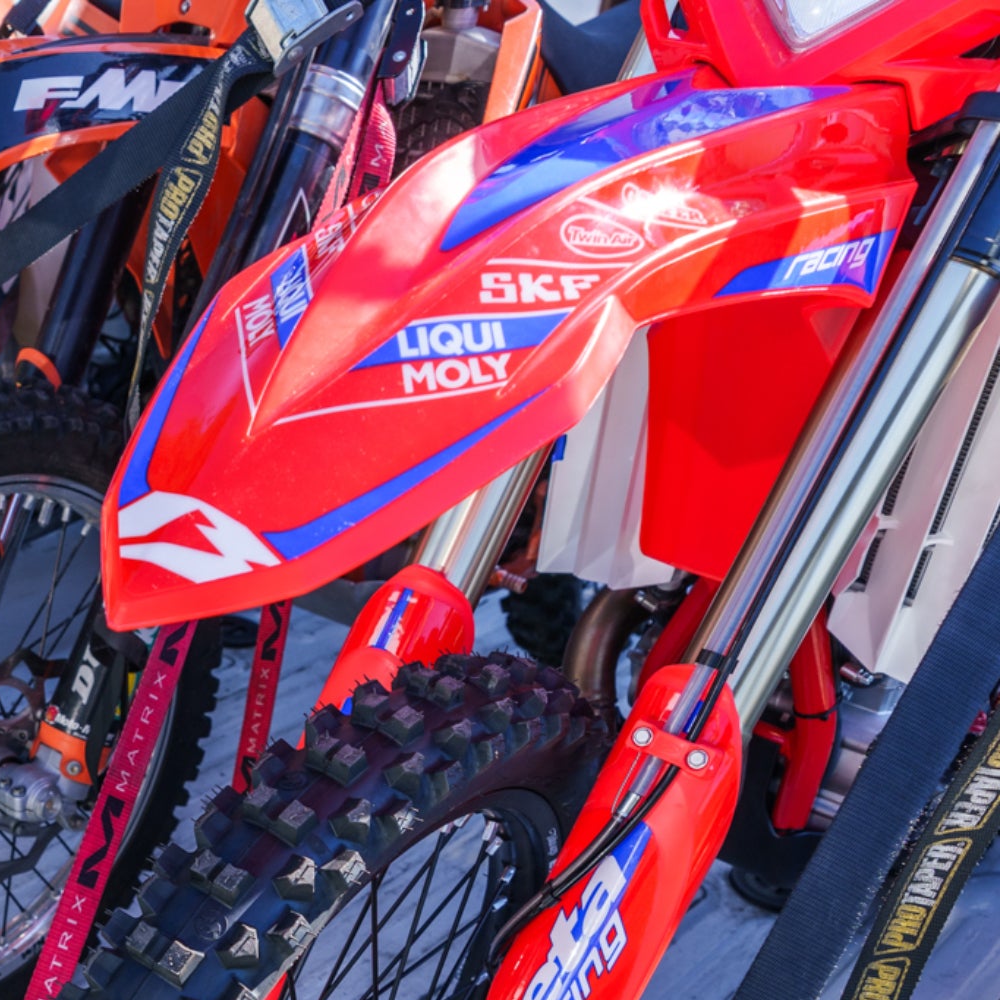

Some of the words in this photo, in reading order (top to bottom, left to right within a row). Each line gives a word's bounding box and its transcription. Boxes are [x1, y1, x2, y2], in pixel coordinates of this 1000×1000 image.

[783, 237, 876, 281] racing
[480, 273, 600, 303] SKF
[243, 294, 275, 348] MOLY
[398, 321, 506, 358] LIQUI
[402, 353, 511, 393] MOLY
[115, 671, 168, 792] MATRIX
[248, 667, 271, 753] MATRIX
